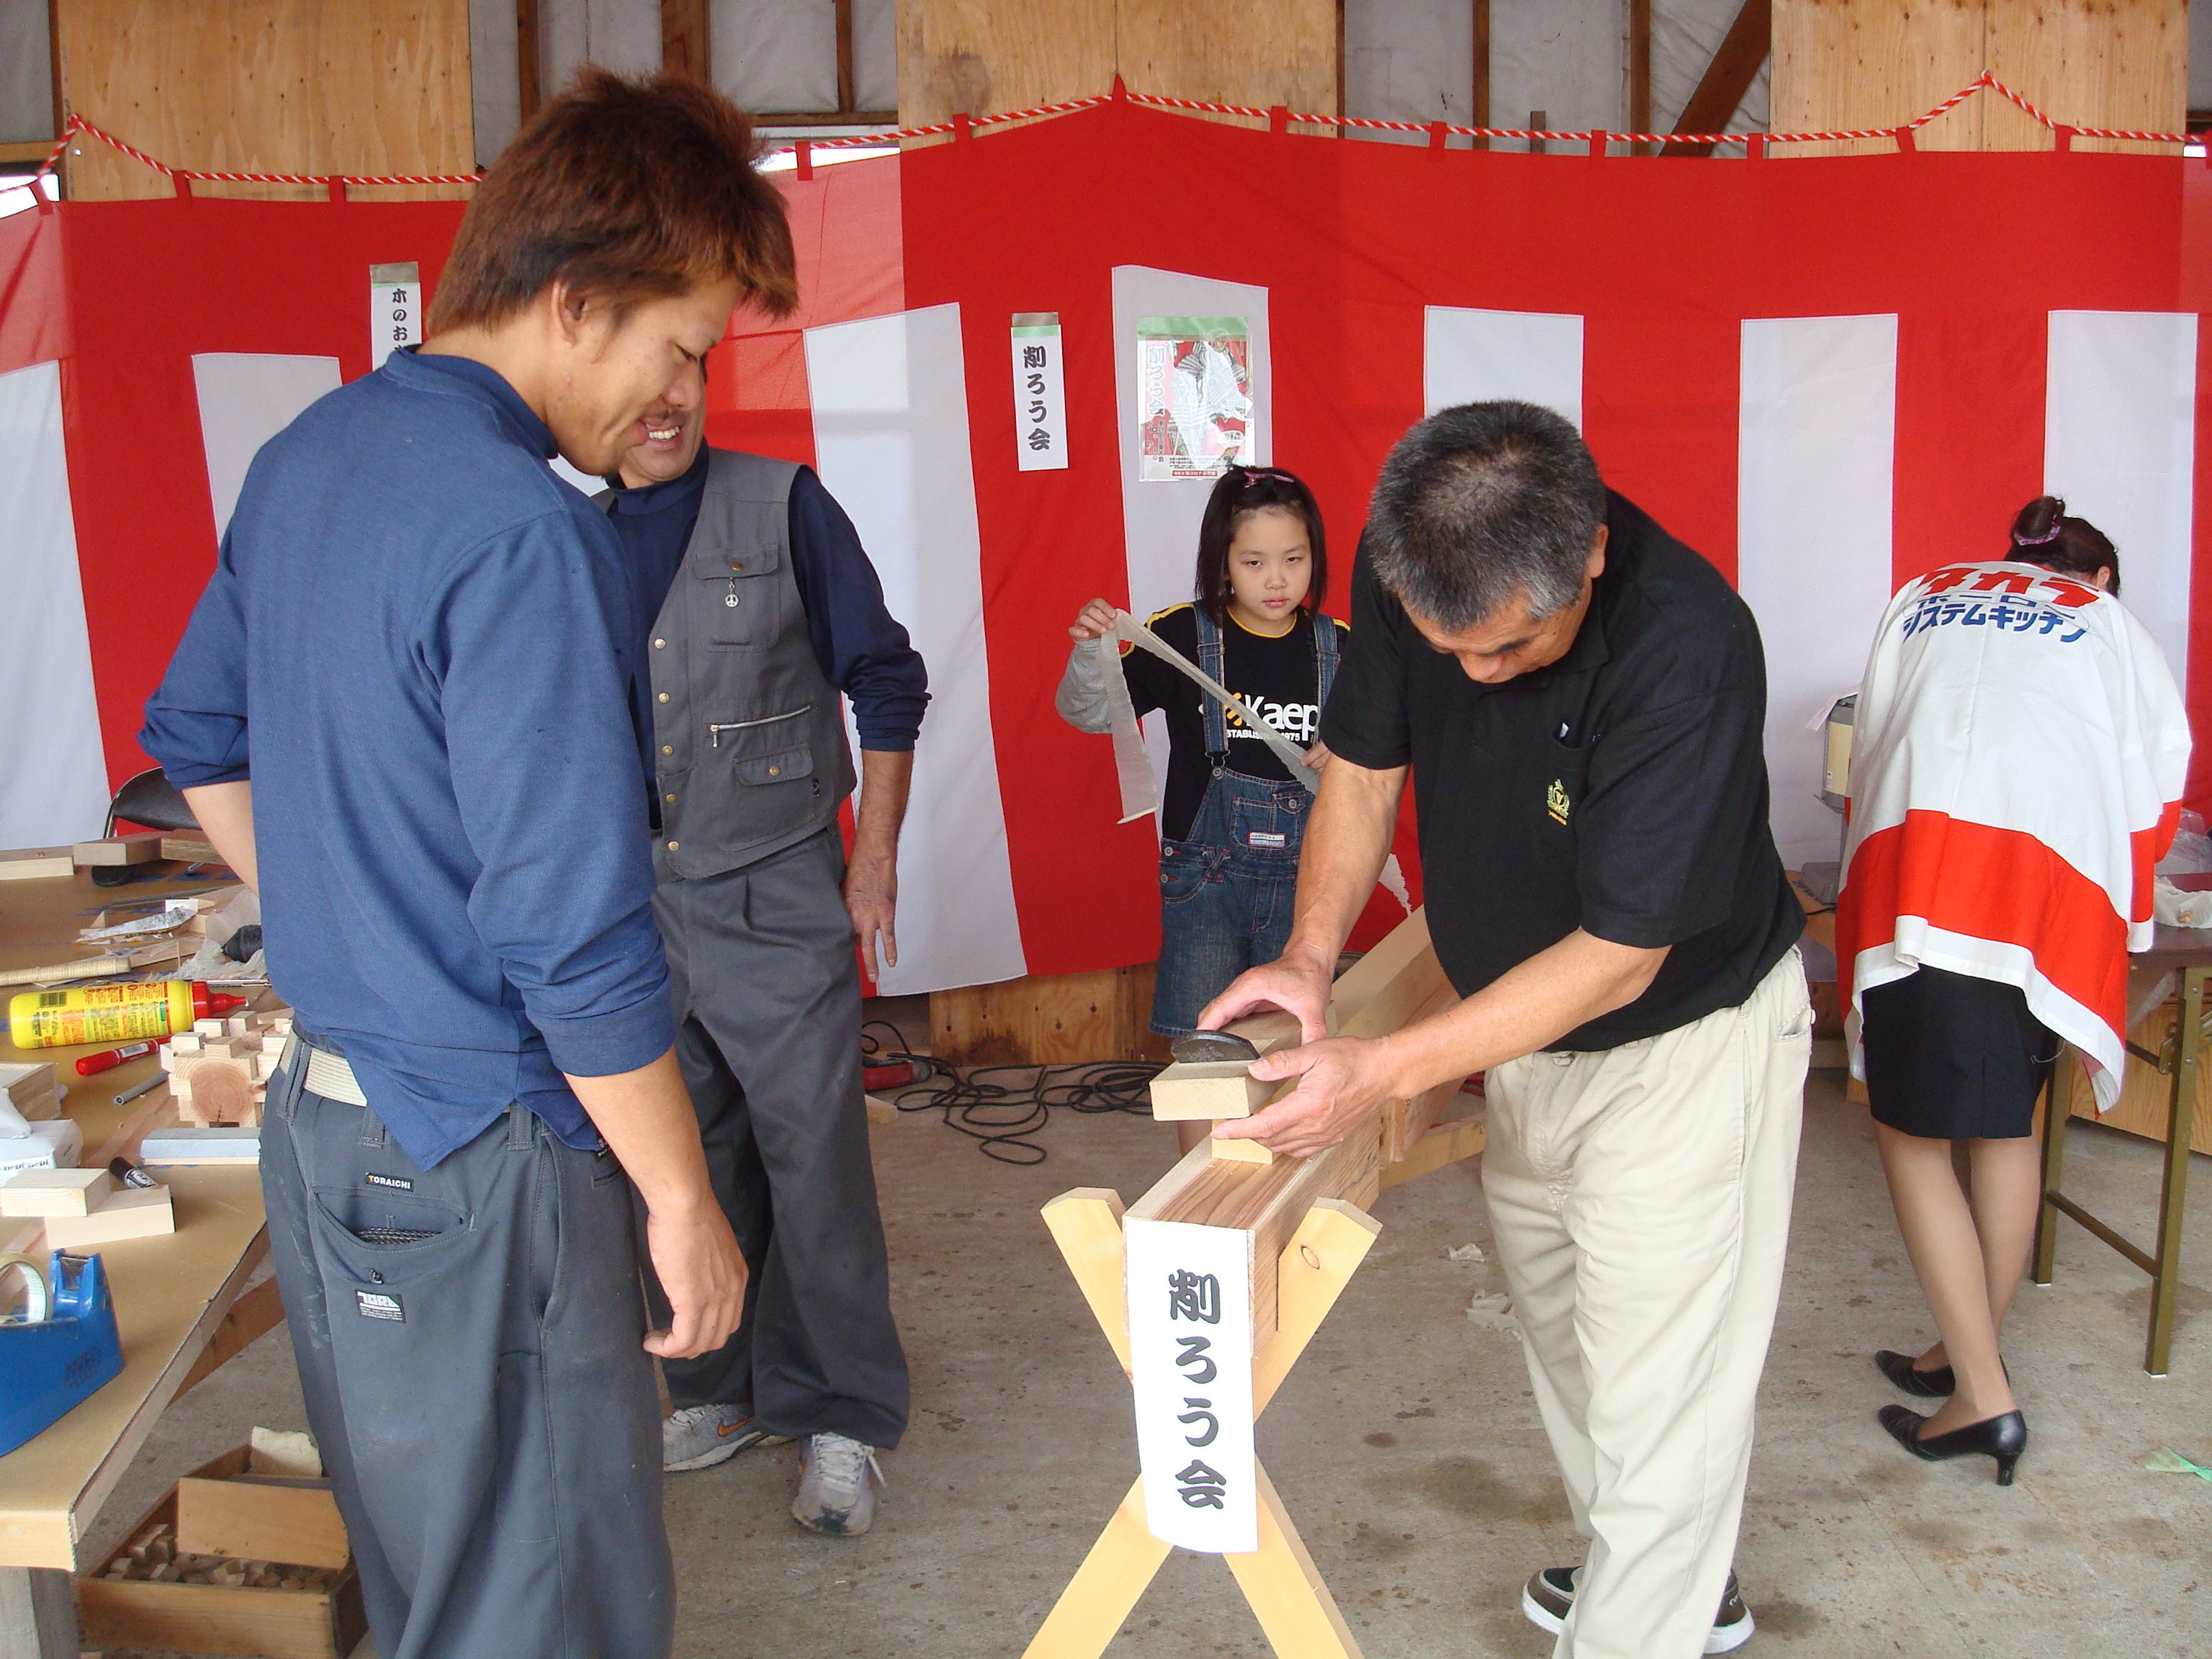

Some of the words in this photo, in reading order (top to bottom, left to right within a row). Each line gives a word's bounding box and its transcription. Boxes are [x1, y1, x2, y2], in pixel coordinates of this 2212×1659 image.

[392, 288, 408, 350] 木のお
[1023, 346, 1051, 451] 削ろう会
[1148, 346, 1164, 415] 削ろう会
[1916, 567, 2100, 608] タカラ
[1902, 603, 2087, 643] システムキッチン
[368, 1174, 411, 1189] TORAICHI
[1168, 1269, 1227, 1509] 削ろう会
